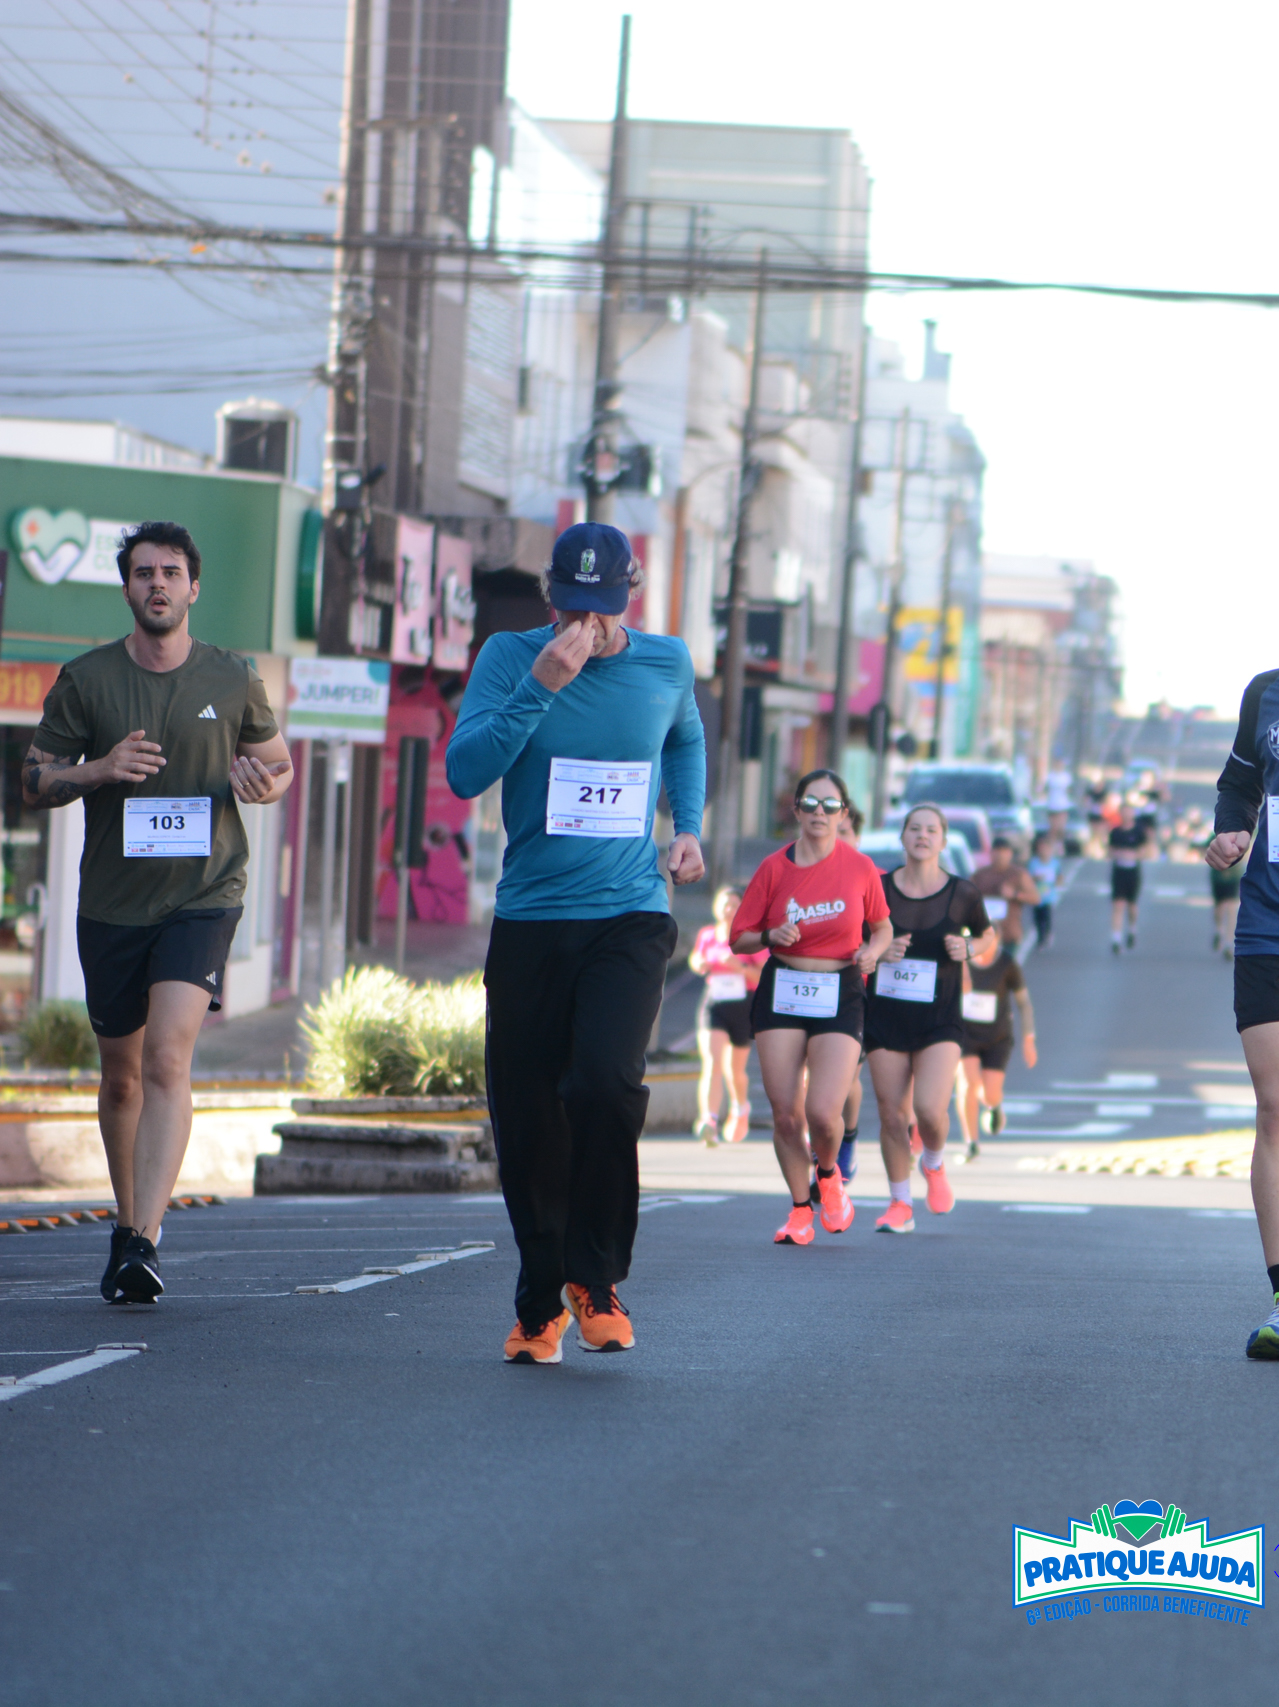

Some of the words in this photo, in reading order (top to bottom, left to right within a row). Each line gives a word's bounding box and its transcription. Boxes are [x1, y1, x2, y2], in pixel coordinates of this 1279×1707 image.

[578, 786, 622, 804] 217
[149, 815, 185, 830] 103
[796, 900, 846, 922] AASLO
[894, 970, 918, 982] 047
[792, 984, 820, 997] 137
